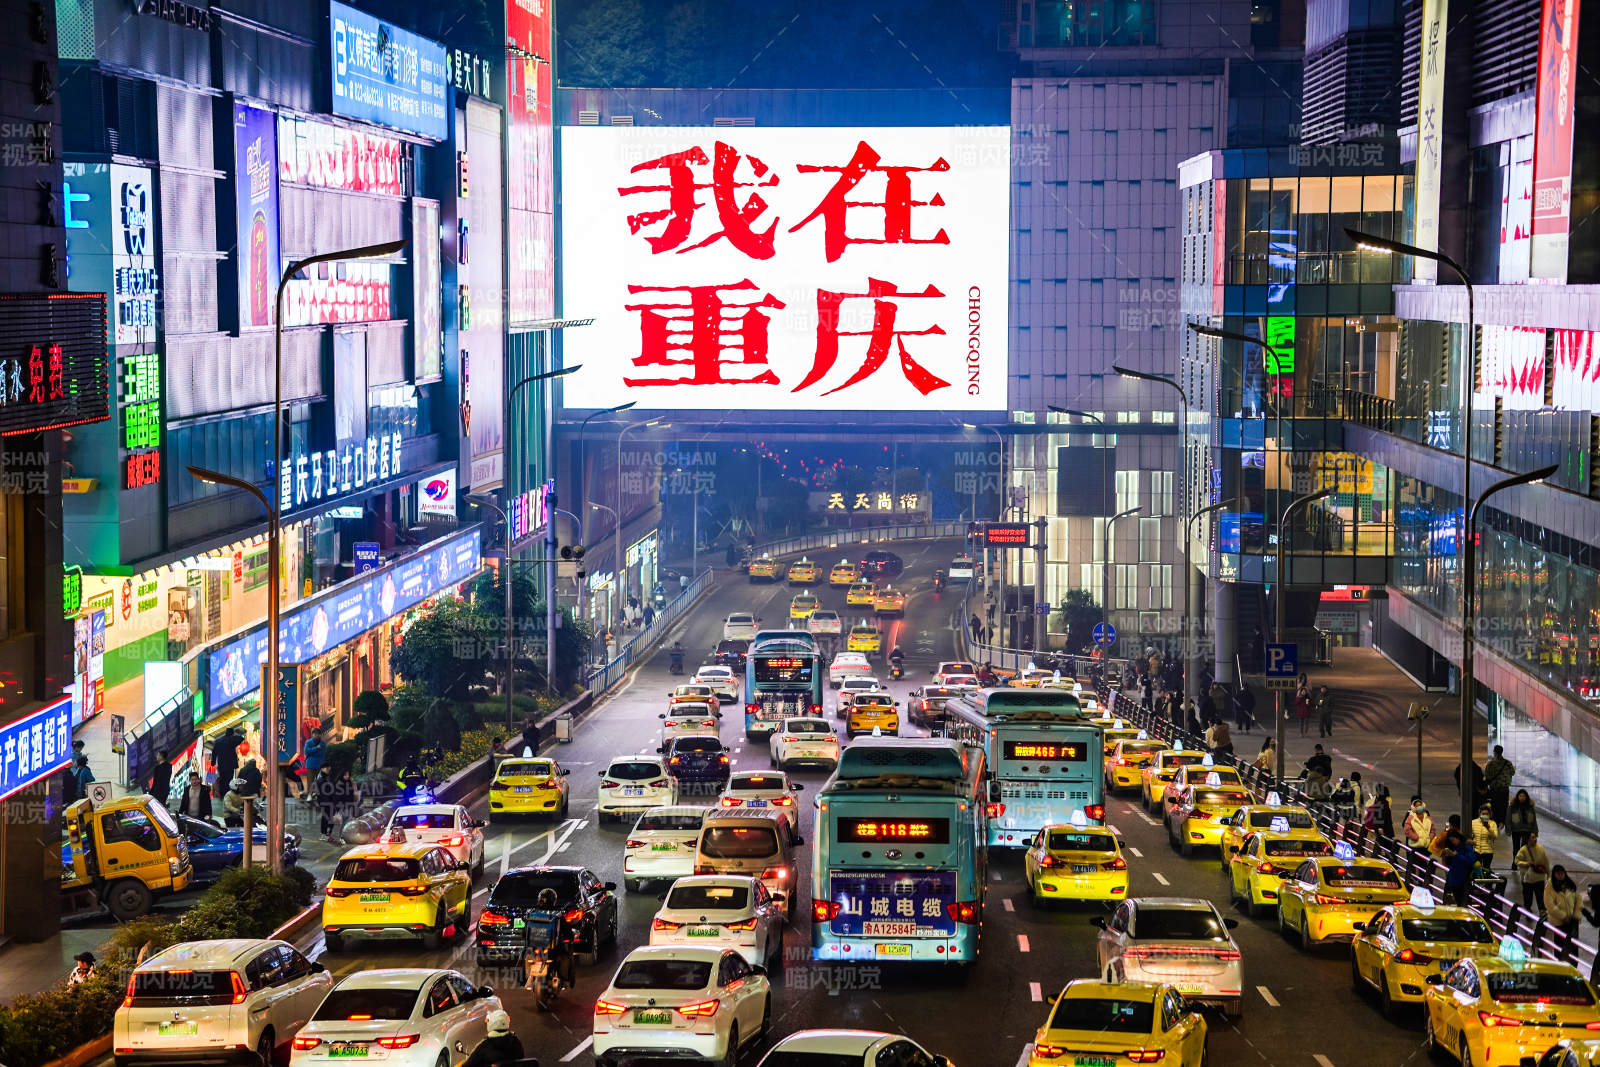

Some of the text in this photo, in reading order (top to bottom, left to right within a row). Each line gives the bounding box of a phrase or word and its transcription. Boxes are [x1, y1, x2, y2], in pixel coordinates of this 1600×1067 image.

[618, 140, 950, 262] 我在
[623, 276, 952, 396] 重庆
[966, 285, 981, 396] CHONGQING
[280, 430, 401, 511] 重庆牙卫士口腔医院
[1335, 456, 1368, 472] CITY
[1269, 648, 1285, 672] P
[848, 896, 942, 918] 山城电缆
[864, 922, 916, 936] 渝A12584F
